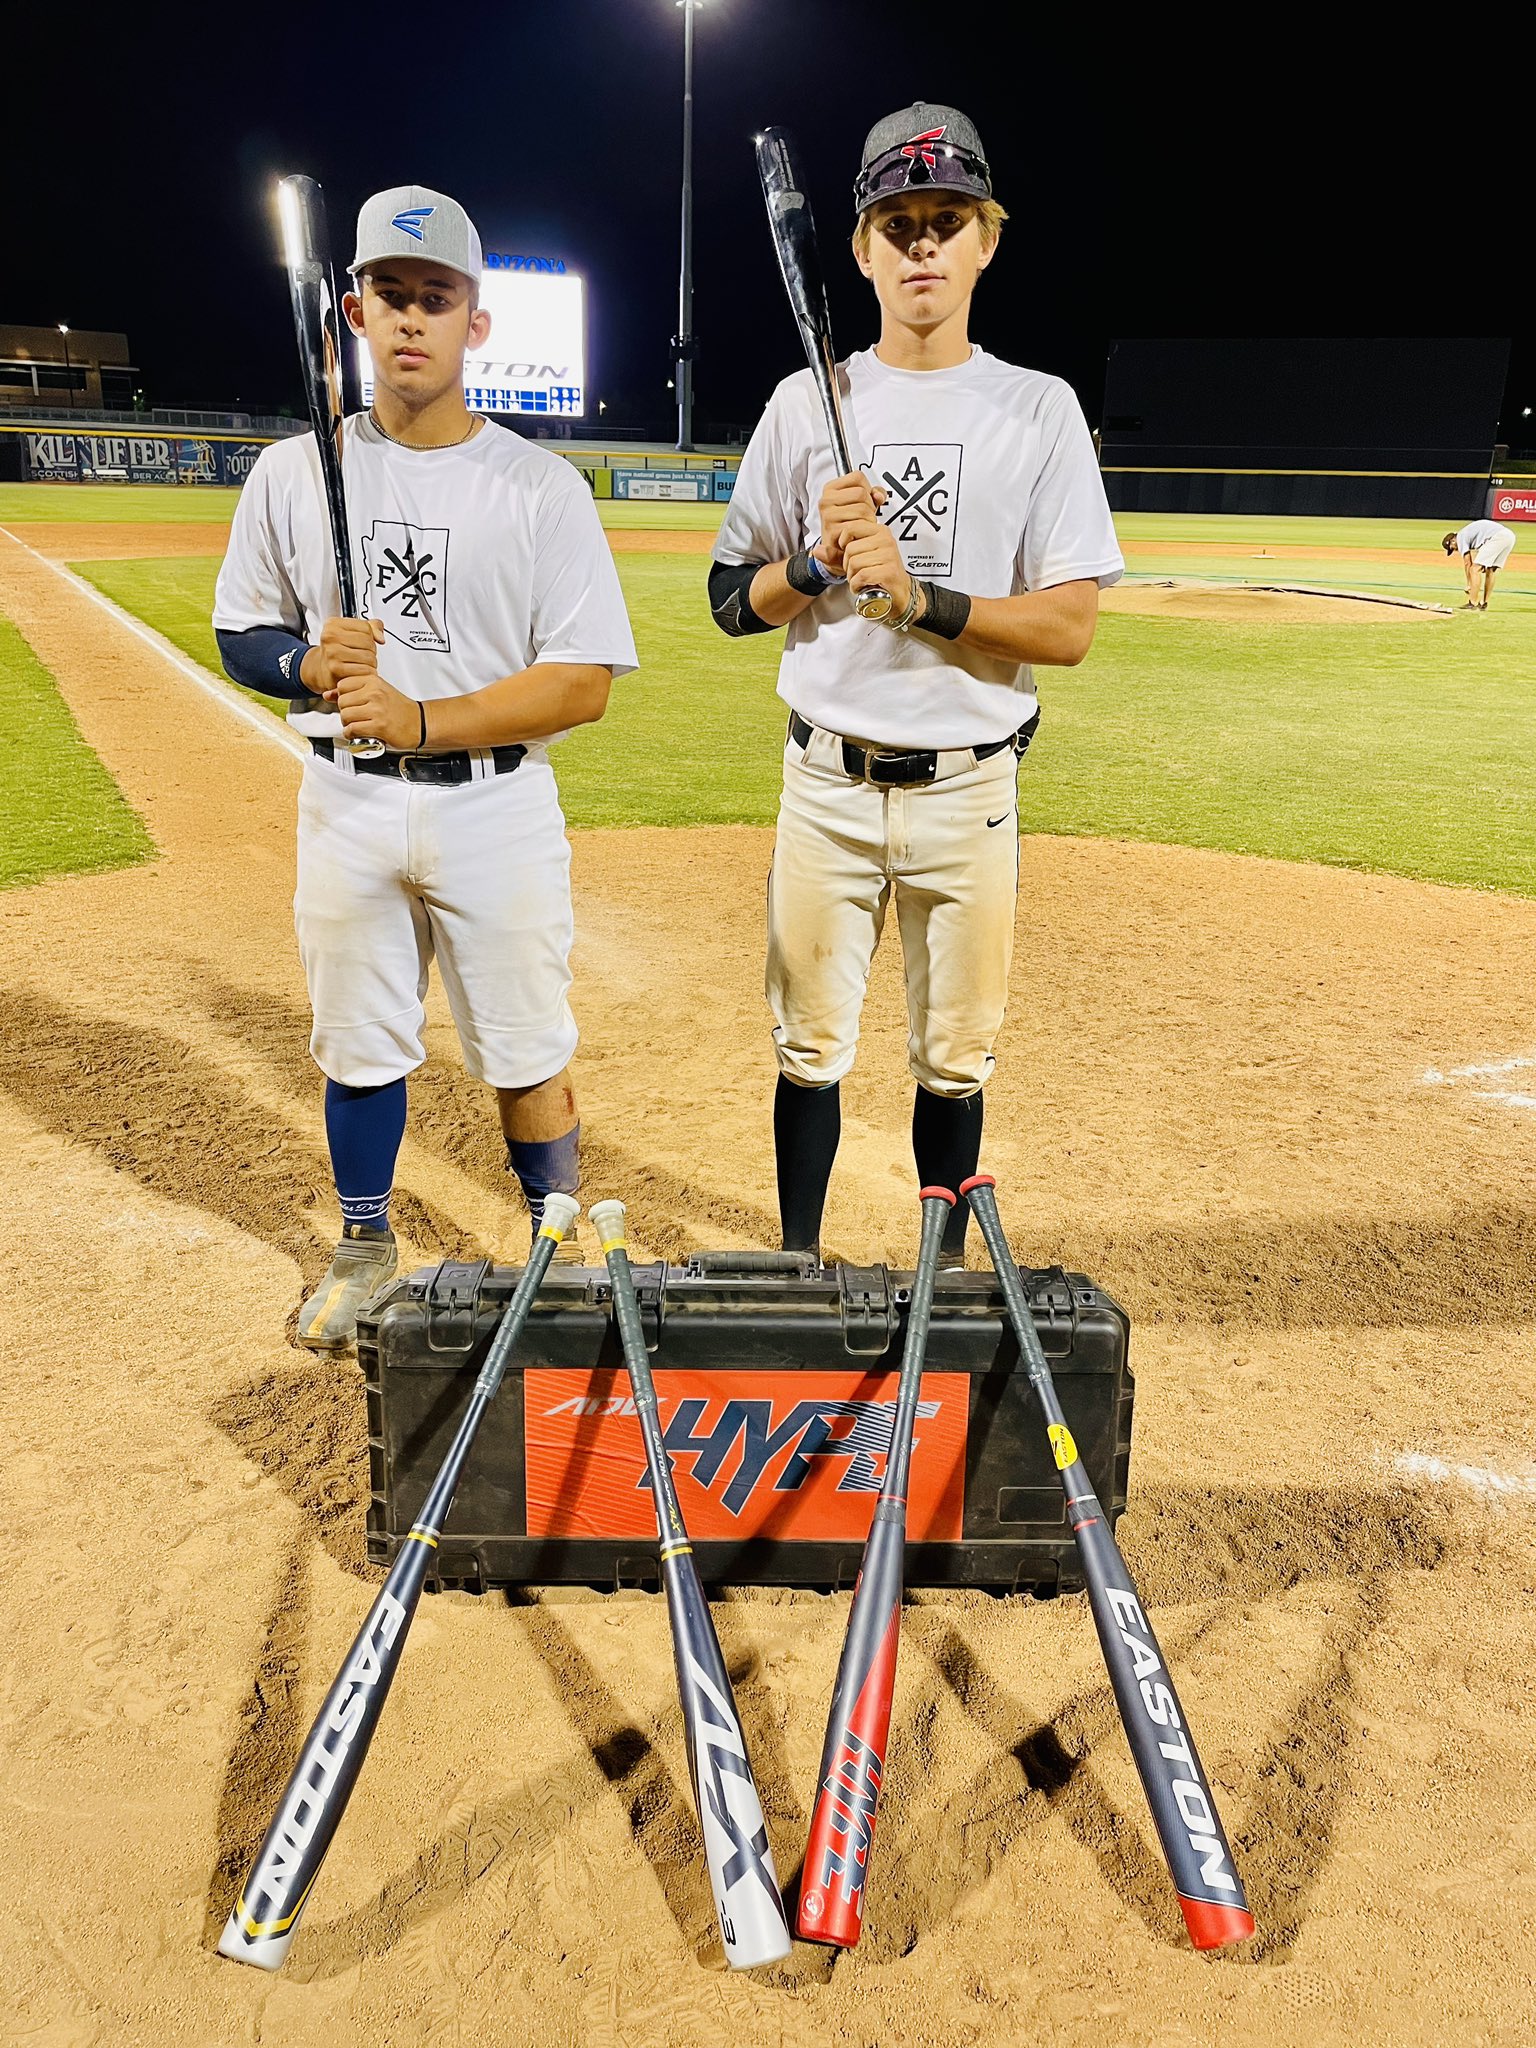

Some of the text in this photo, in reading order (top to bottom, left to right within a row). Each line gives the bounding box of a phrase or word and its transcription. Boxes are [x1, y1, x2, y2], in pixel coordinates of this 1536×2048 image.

[486, 253, 566, 274] RIZONA
[901, 456, 924, 481] A
[927, 489, 949, 516] C
[899, 515, 918, 541] Z
[376, 564, 437, 596] F C
[400, 592, 420, 618] Z
[417, 637, 447, 645] EASTON
[284, 647, 298, 679] adidas
[652, 1430, 668, 1478] EASTON
[258, 1590, 408, 1911] EASTON
[1104, 1586, 1238, 1893] EASTON
